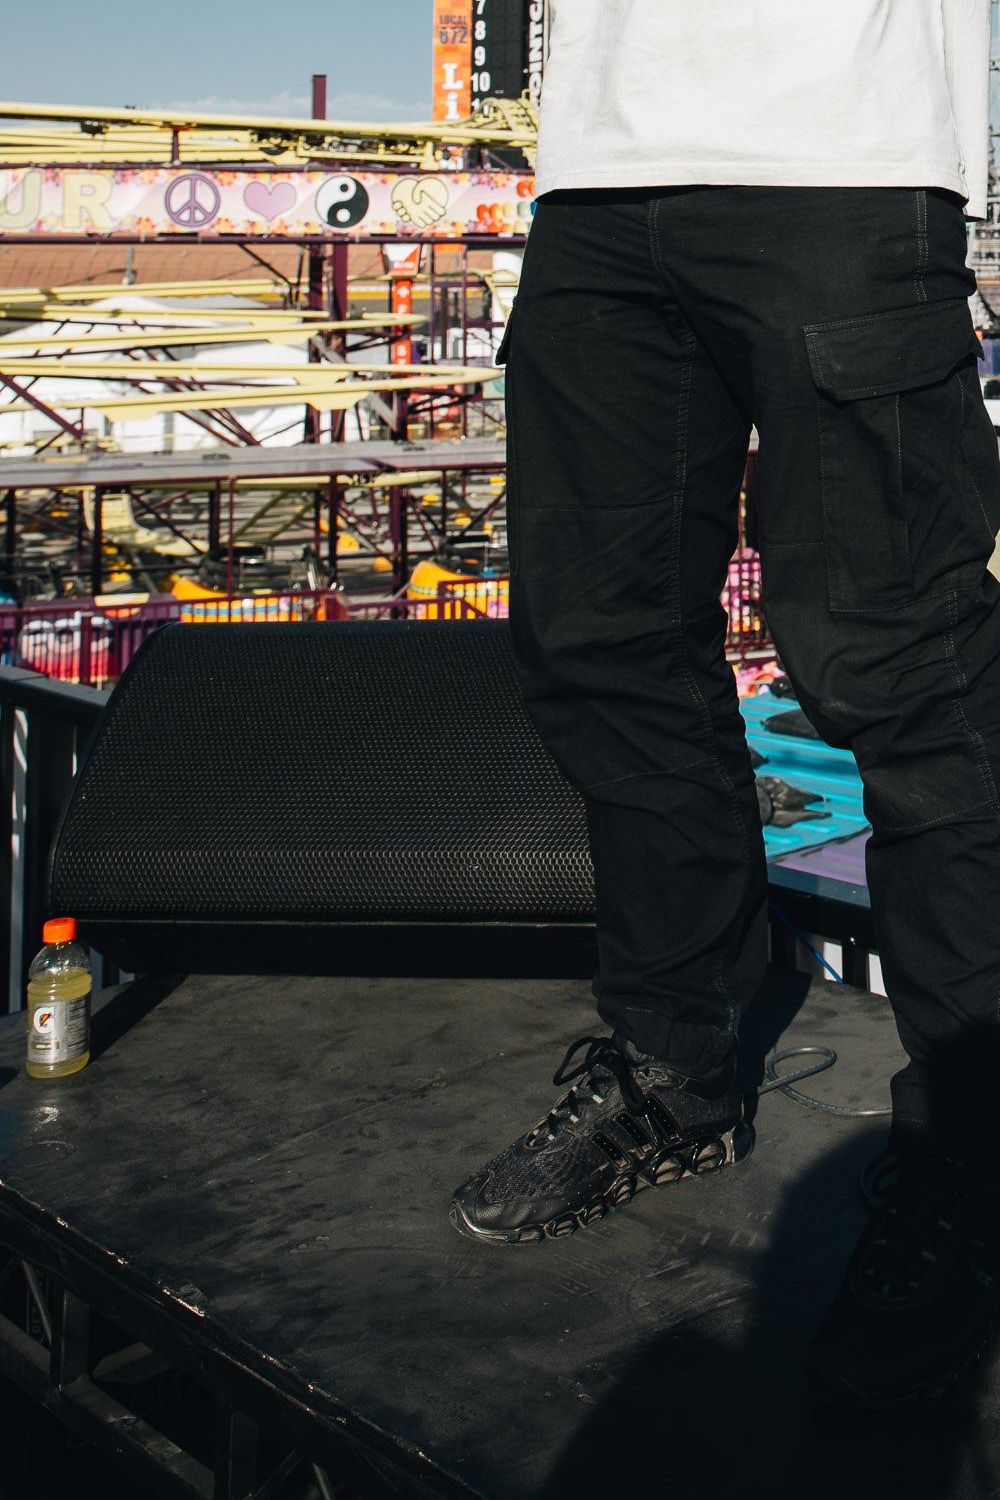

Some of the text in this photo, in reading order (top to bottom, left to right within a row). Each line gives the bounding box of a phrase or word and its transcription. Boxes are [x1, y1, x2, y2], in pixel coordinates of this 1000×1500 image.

[439, 15, 467, 25] LOCAL
[474, 20, 486, 41] 8
[474, 46, 486, 67] 9
[470, 71, 491, 93] 10
